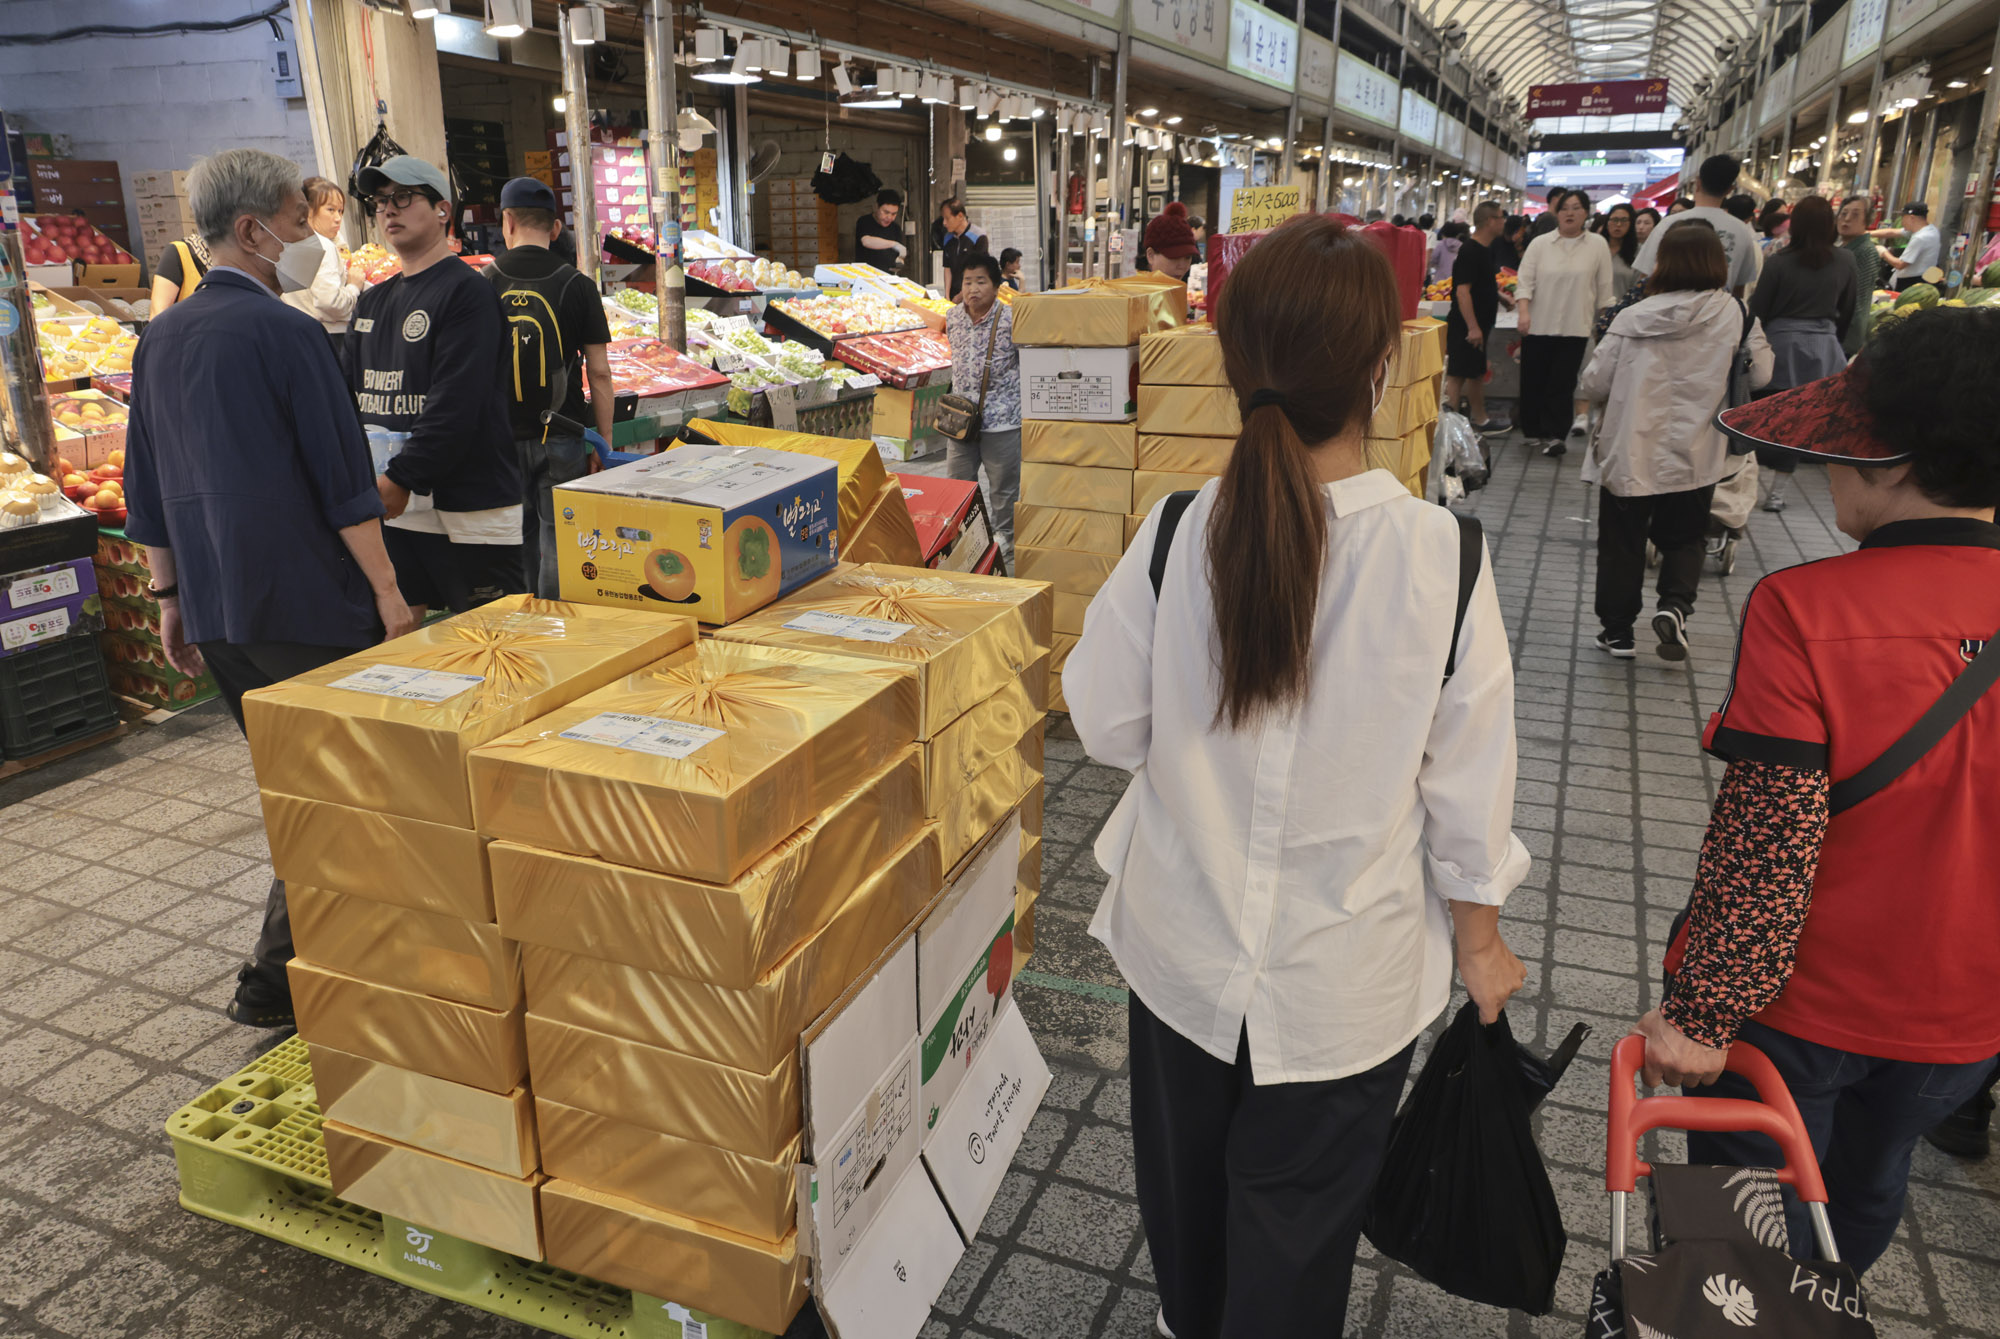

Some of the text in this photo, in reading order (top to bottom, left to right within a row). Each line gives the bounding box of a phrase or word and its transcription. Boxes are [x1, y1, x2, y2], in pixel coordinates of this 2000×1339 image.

[364, 369, 404, 391] BOWERY
[578, 531, 635, 560] 별그리고
[582, 562, 598, 579] 단감
